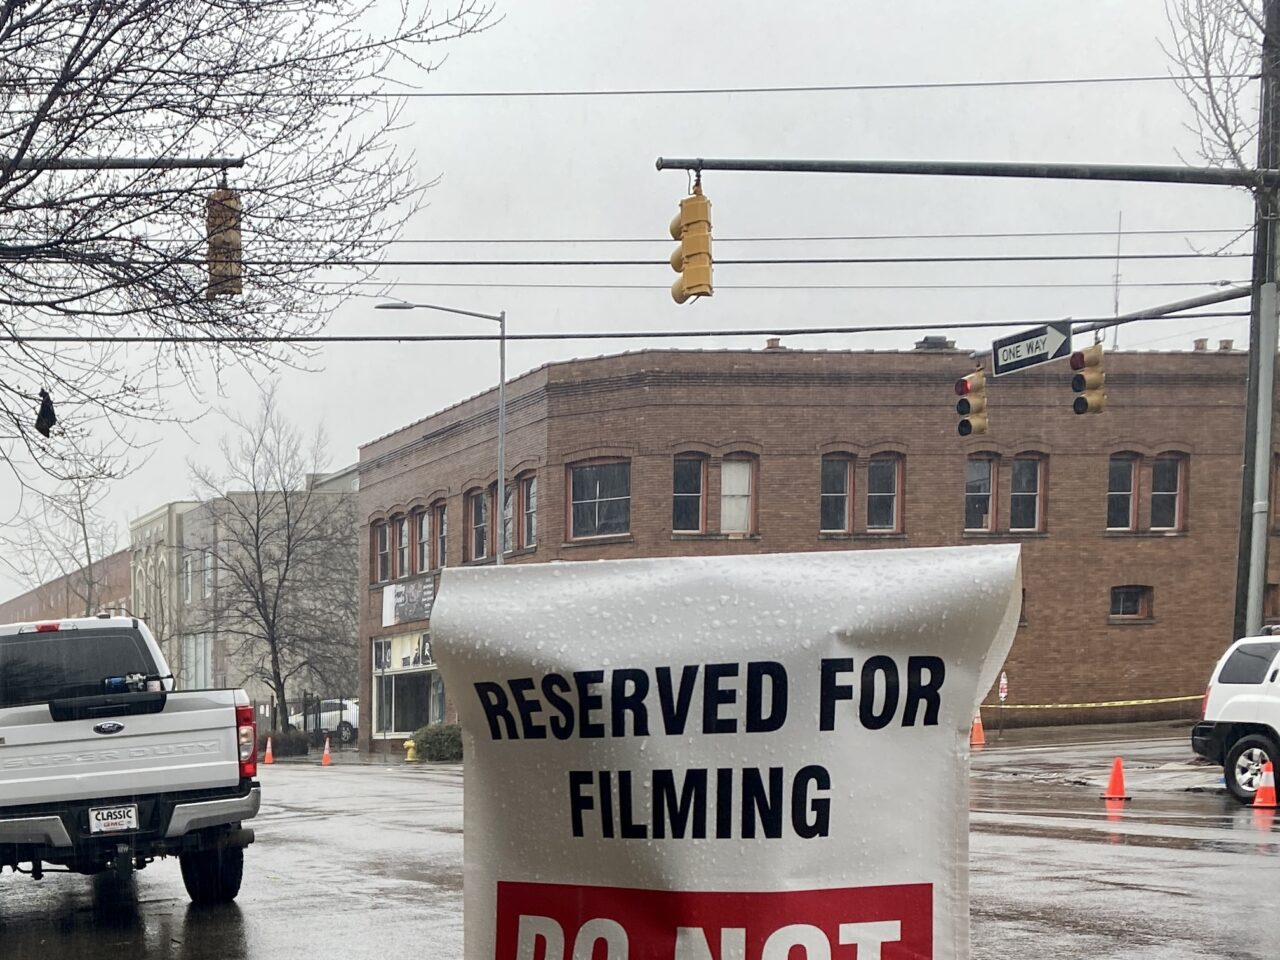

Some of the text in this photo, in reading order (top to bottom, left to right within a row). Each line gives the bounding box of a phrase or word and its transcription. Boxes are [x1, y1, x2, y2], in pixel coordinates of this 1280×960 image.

[1002, 337, 1047, 362] ONE WAY
[473, 655, 946, 740] RESERVED FOR
[3, 741, 218, 769] SUPER DUTY
[95, 809, 133, 821] CLASSIC
[568, 764, 831, 840] FILMING
